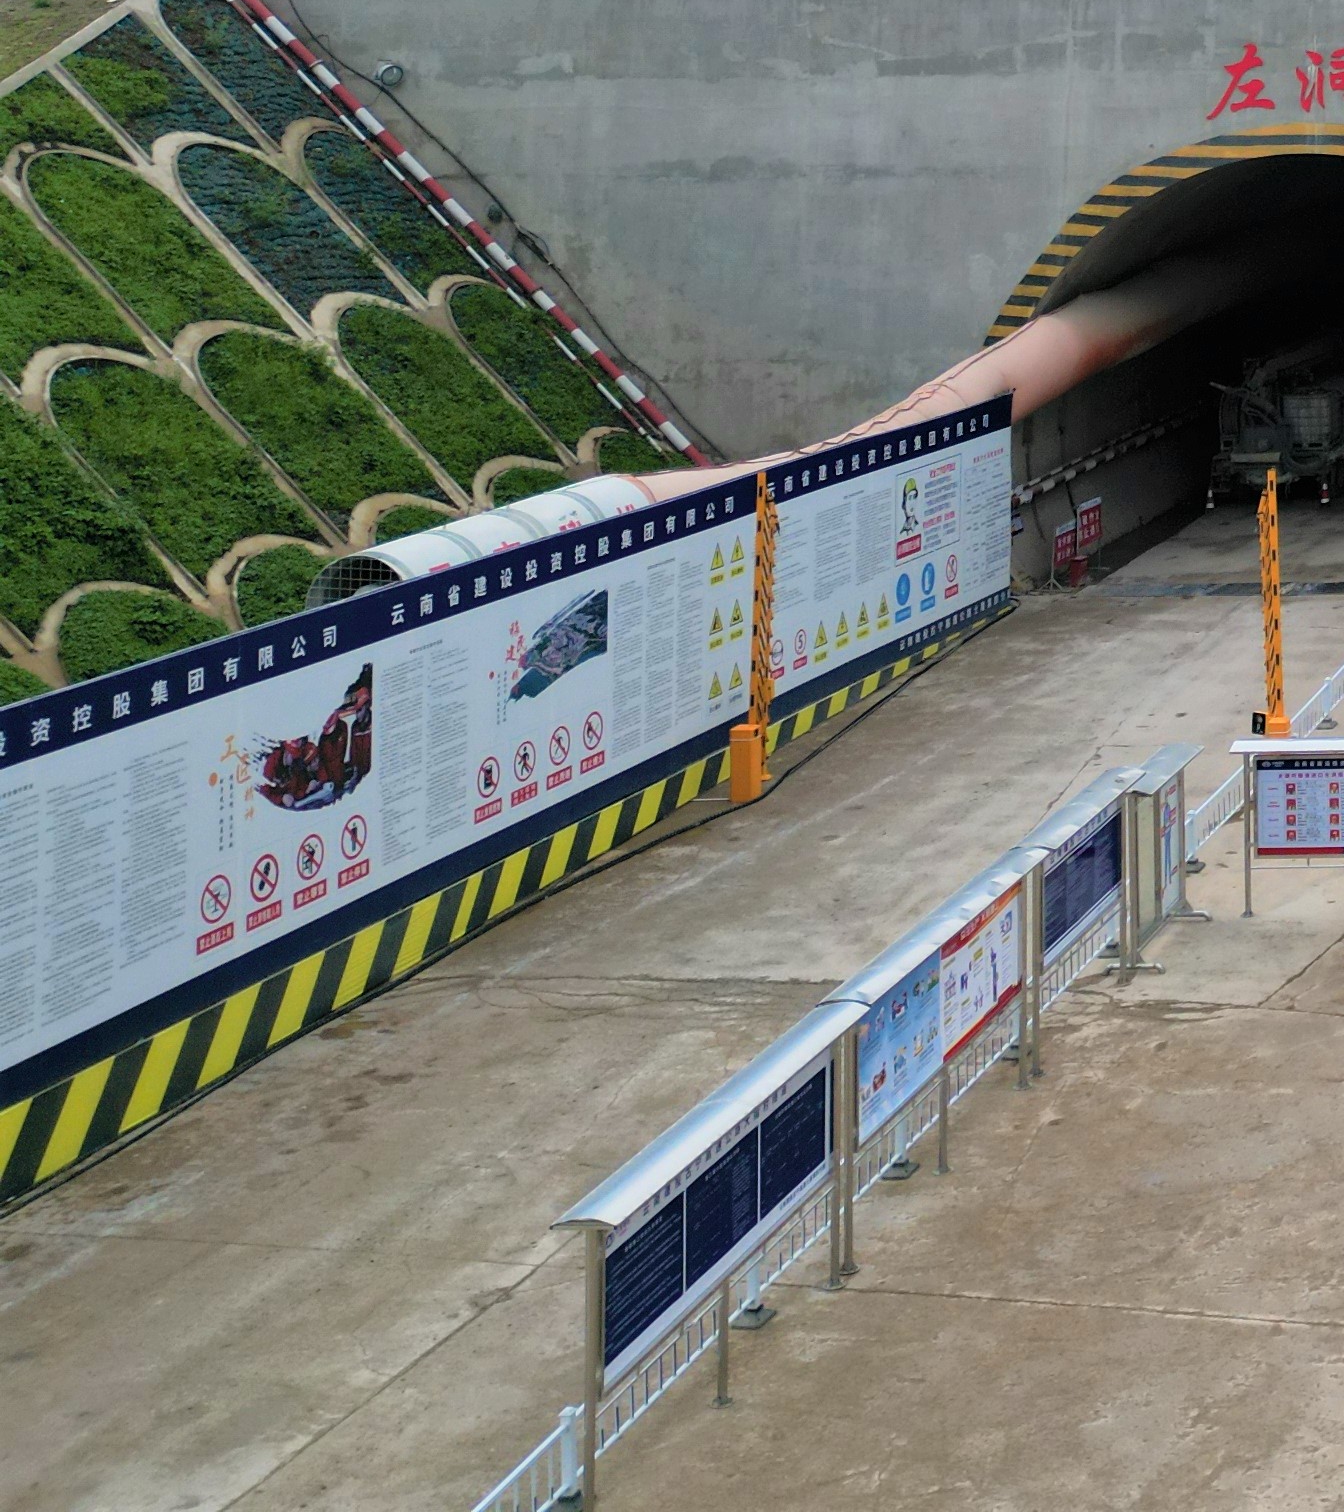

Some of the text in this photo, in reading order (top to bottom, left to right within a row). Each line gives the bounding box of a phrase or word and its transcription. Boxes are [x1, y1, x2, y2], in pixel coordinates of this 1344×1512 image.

[390, 496, 737, 626] 云南省建设投资控股集团有限公司
